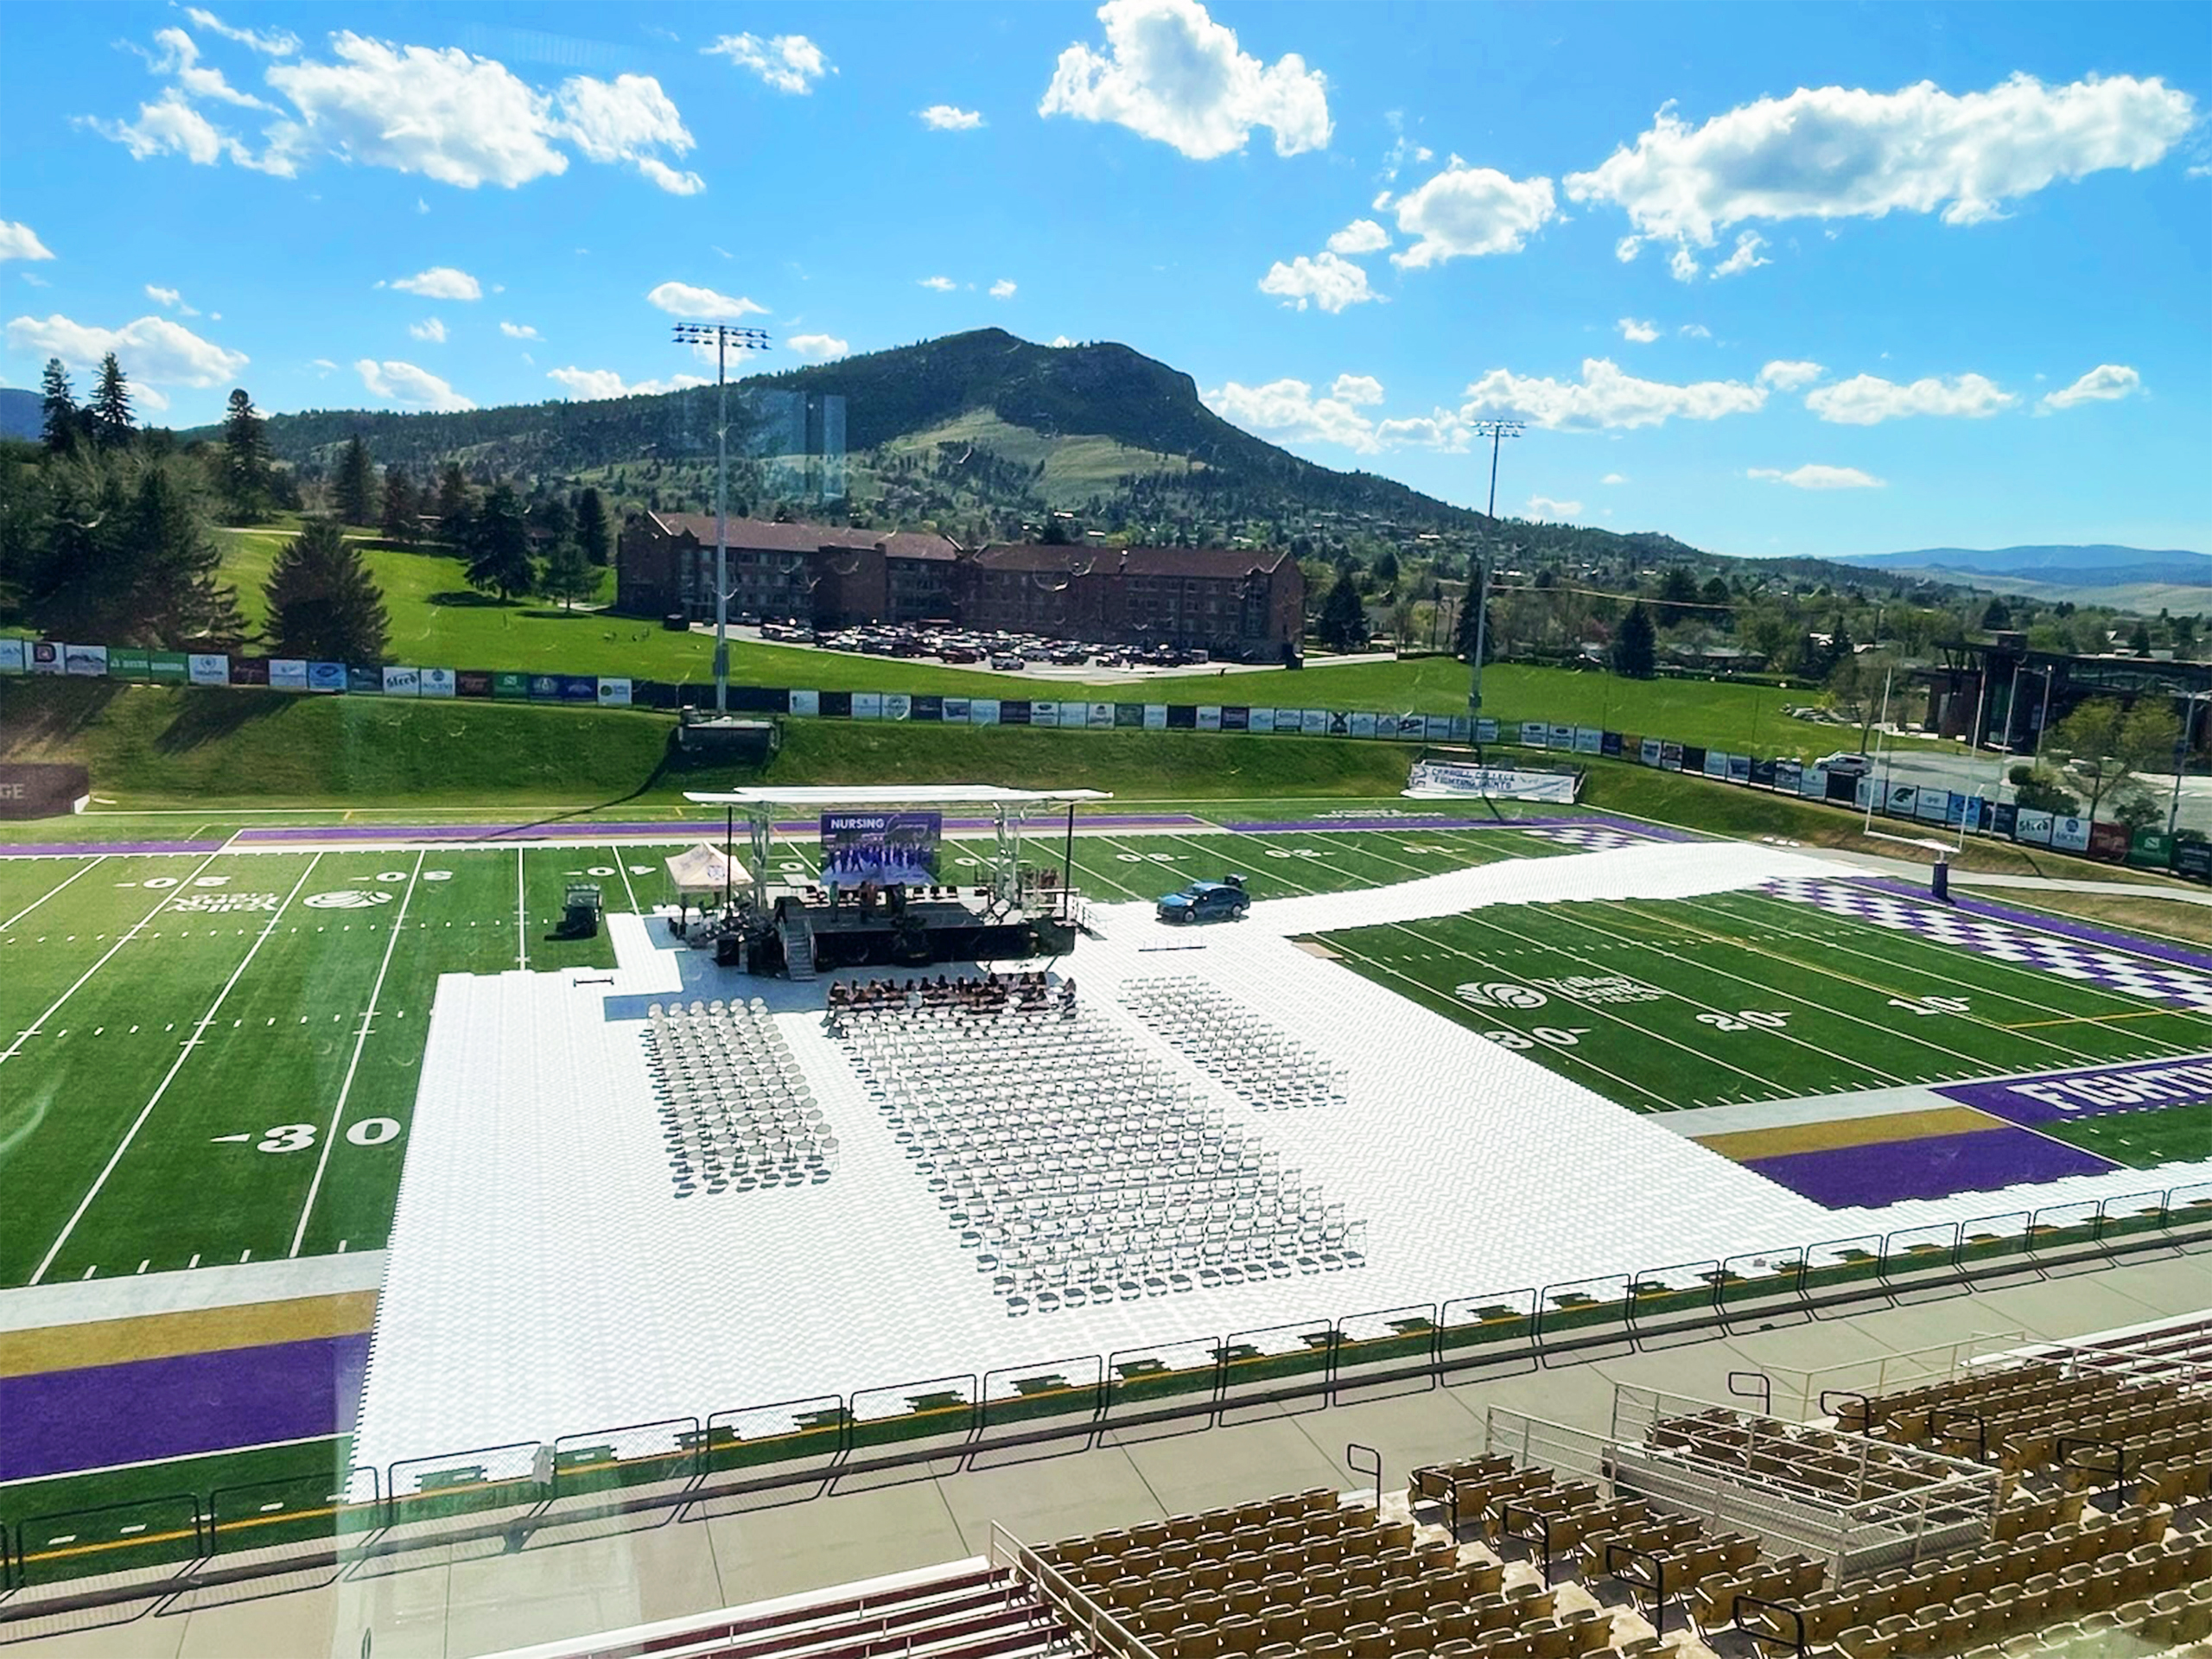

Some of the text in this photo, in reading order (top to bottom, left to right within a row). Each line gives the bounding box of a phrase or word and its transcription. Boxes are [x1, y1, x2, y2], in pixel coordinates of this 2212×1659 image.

[1475, 771, 1516, 782] COLLEGE
[830, 817, 885, 830] NURSING
[1887, 995, 1971, 1015] 10
[1695, 1010, 1787, 1032] 20
[1484, 1027, 1580, 1050] 30
[257, 1117, 401, 1153] 30
